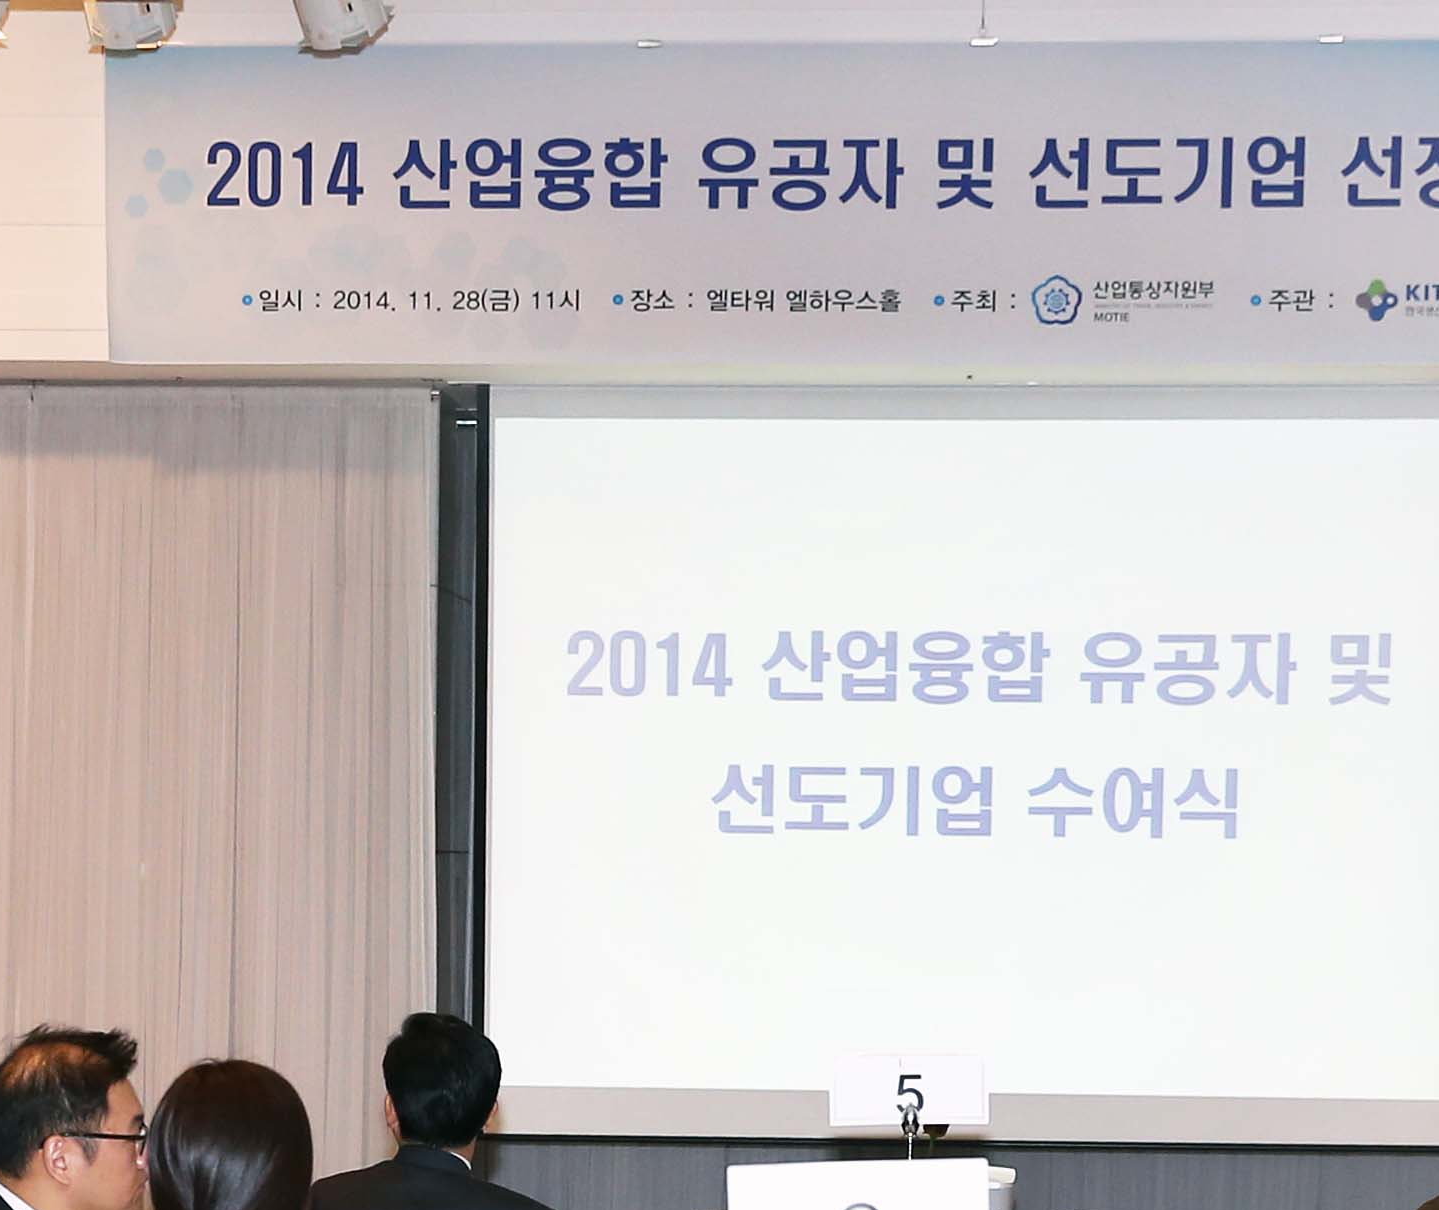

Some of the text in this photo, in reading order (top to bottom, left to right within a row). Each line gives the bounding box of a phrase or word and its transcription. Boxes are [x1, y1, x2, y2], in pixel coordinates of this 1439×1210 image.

[206, 140, 365, 208] 2014
[392, 137, 669, 212] 산업융합
[698, 137, 905, 212] 유공자
[936, 137, 995, 210] 및
[1028, 135, 1306, 209] 선도기업
[258, 288, 302, 313] 일시
[332, 289, 396, 312] 2014.
[408, 290, 442, 313] 11.
[452, 287, 520, 313] 28(금)
[531, 288, 581, 312] 11시
[630, 288, 675, 313] 장소
[706, 288, 775, 313] 엘타워
[785, 288, 902, 313] 엘하우스홀
[950, 289, 997, 313] 주최
[1092, 280, 1215, 300] 산업통상자원부
[1268, 288, 1316, 313] 주관
[1093, 311, 1130, 323] MOTIE
[566, 630, 1392, 707] 2014 산업융합 유공자 및
[711, 764, 1239, 840] 선도기업 수여식
[896, 1074, 924, 1113] 5
